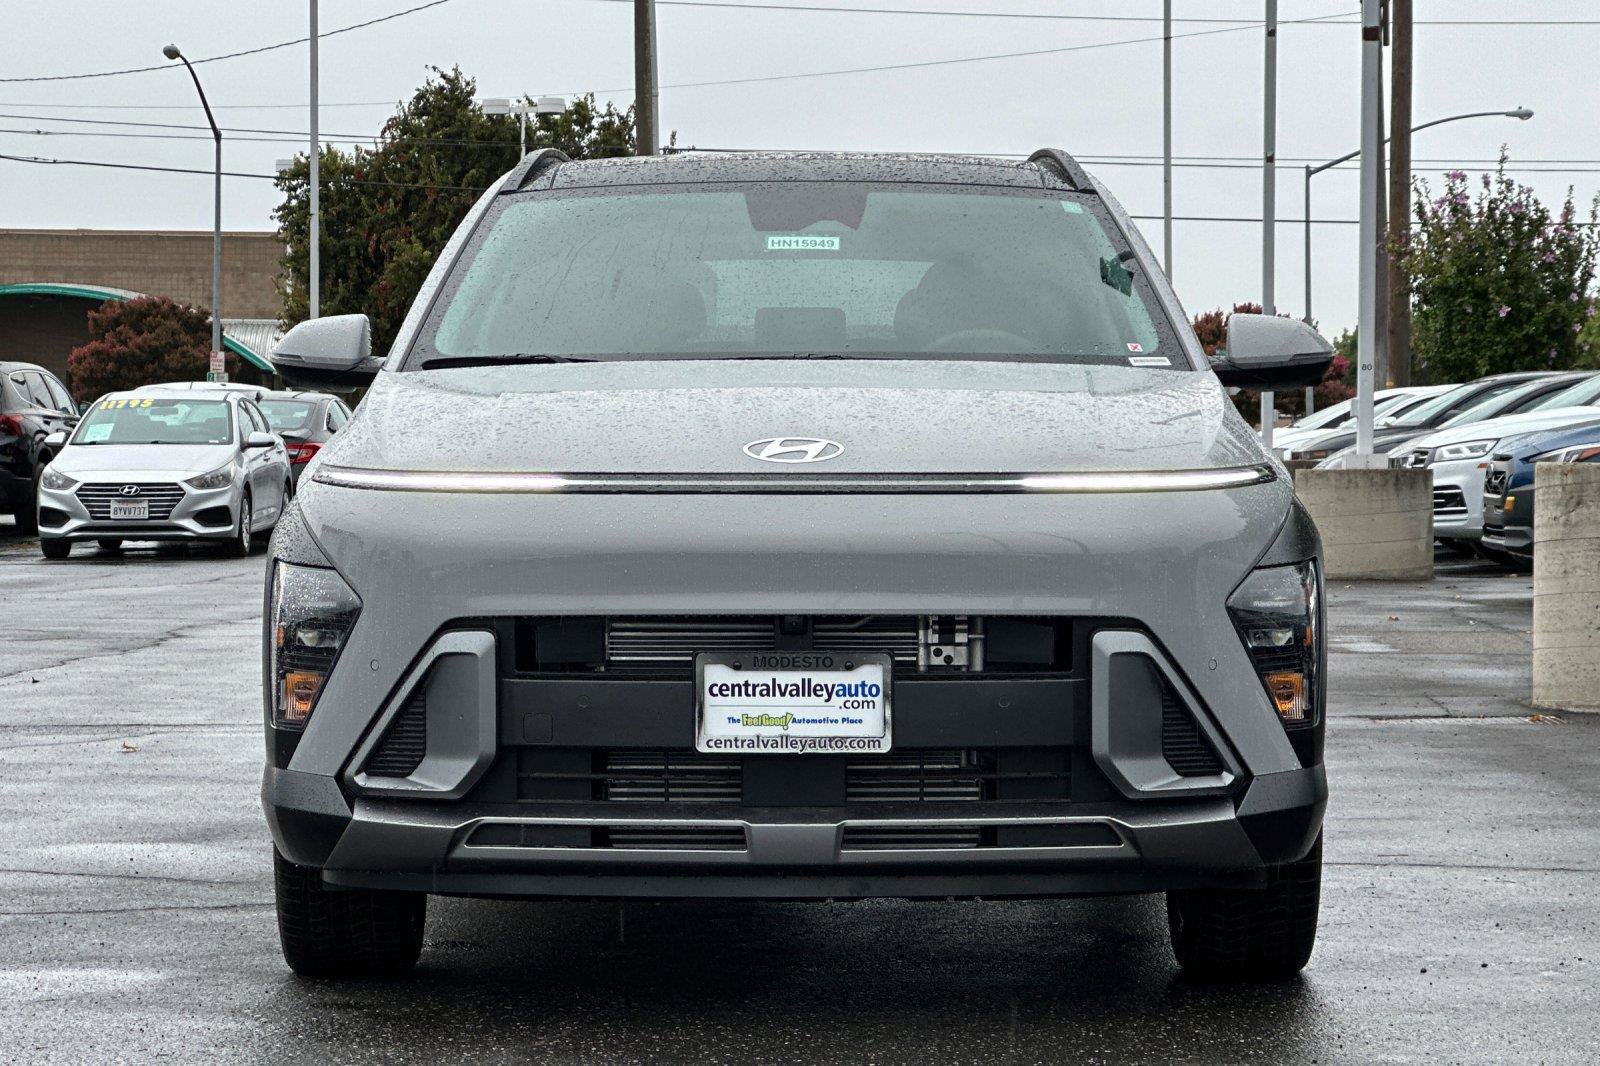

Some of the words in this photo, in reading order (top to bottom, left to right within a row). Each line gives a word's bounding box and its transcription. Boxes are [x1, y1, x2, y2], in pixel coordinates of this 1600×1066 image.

[771, 239, 835, 248] HN15949
[753, 655, 834, 669] MODESTO
[708, 678, 881, 703] centralvalleyauto
[838, 699, 876, 710] .com
[727, 716, 741, 724] The
[791, 716, 839, 725] Automotive
[705, 735, 881, 752] centralvalleyauto.com
